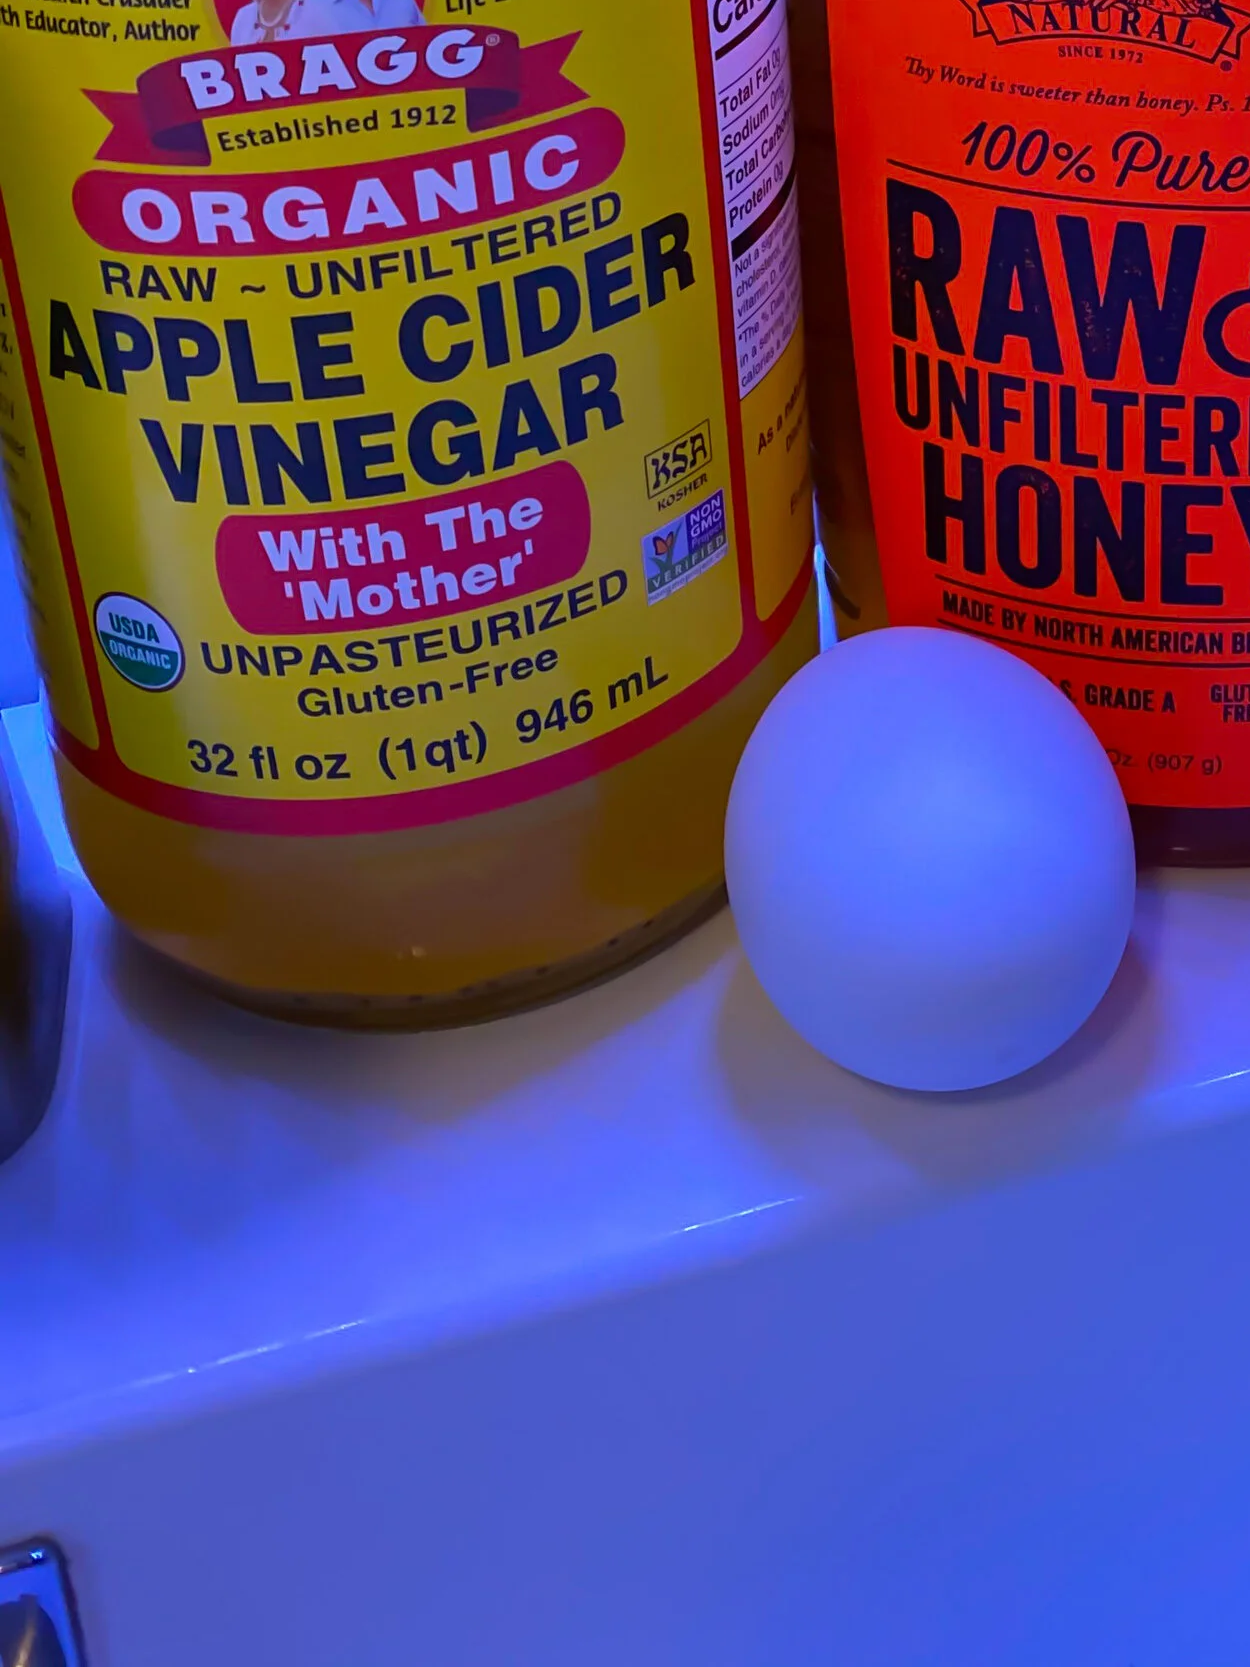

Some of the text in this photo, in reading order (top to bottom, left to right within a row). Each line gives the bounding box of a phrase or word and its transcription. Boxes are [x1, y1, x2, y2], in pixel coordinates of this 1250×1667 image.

[25, 10, 117, 42] Educator,
[125, 20, 201, 41] Author
[1007, 3, 1197, 48] NATURAL
[1058, 45, 1144, 64] SINCE 1972
[719, 78, 753, 118] Total
[756, 63, 772, 90] Fat
[905, 56, 935, 83] Thy
[940, 64, 986, 90] Word
[991, 77, 1005, 94] is
[1009, 83, 1082, 103] sweeter
[1086, 87, 1130, 108] than
[1136, 91, 1199, 115] honey.
[1205, 93, 1235, 112] Ps.
[217, 105, 456, 152] Established 1912
[722, 104, 770, 156] Sodium
[962, 121, 1096, 184] 100%
[122, 134, 580, 244] ORGANIC
[726, 153, 759, 191] Total
[729, 176, 774, 228] Protein
[100, 259, 217, 303] RAW
[286, 192, 621, 299] UNFILTERED
[735, 253, 752, 278] Not
[886, 176, 1207, 386] RAW
[49, 212, 695, 404] APPLE CIDER
[139, 353, 624, 506] VINEGAR
[758, 427, 774, 455] As
[651, 432, 707, 489] KSA
[657, 472, 708, 512] KOSHER
[690, 496, 721, 525] NON
[258, 497, 543, 572] With The
[691, 509, 722, 538] GMO
[284, 539, 534, 622] 'Mother'
[652, 535, 724, 588] VERIFIED
[108, 612, 160, 643] USDA
[201, 569, 627, 678] UNPASTEURIZED
[942, 591, 994, 626] MADE
[1002, 610, 1026, 633] BY
[1034, 616, 1103, 647] NORTH
[1111, 628, 1223, 656] AMERICAN
[109, 639, 172, 670] ORGANIC
[297, 648, 559, 717] Gluten-Free
[1084, 684, 1155, 712] GRADE
[1161, 691, 1176, 714] A
[187, 656, 669, 781] 32 fl oz (1qt) 946 mL
[1147, 753, 1195, 773] (907
[1202, 755, 1222, 776] g)
